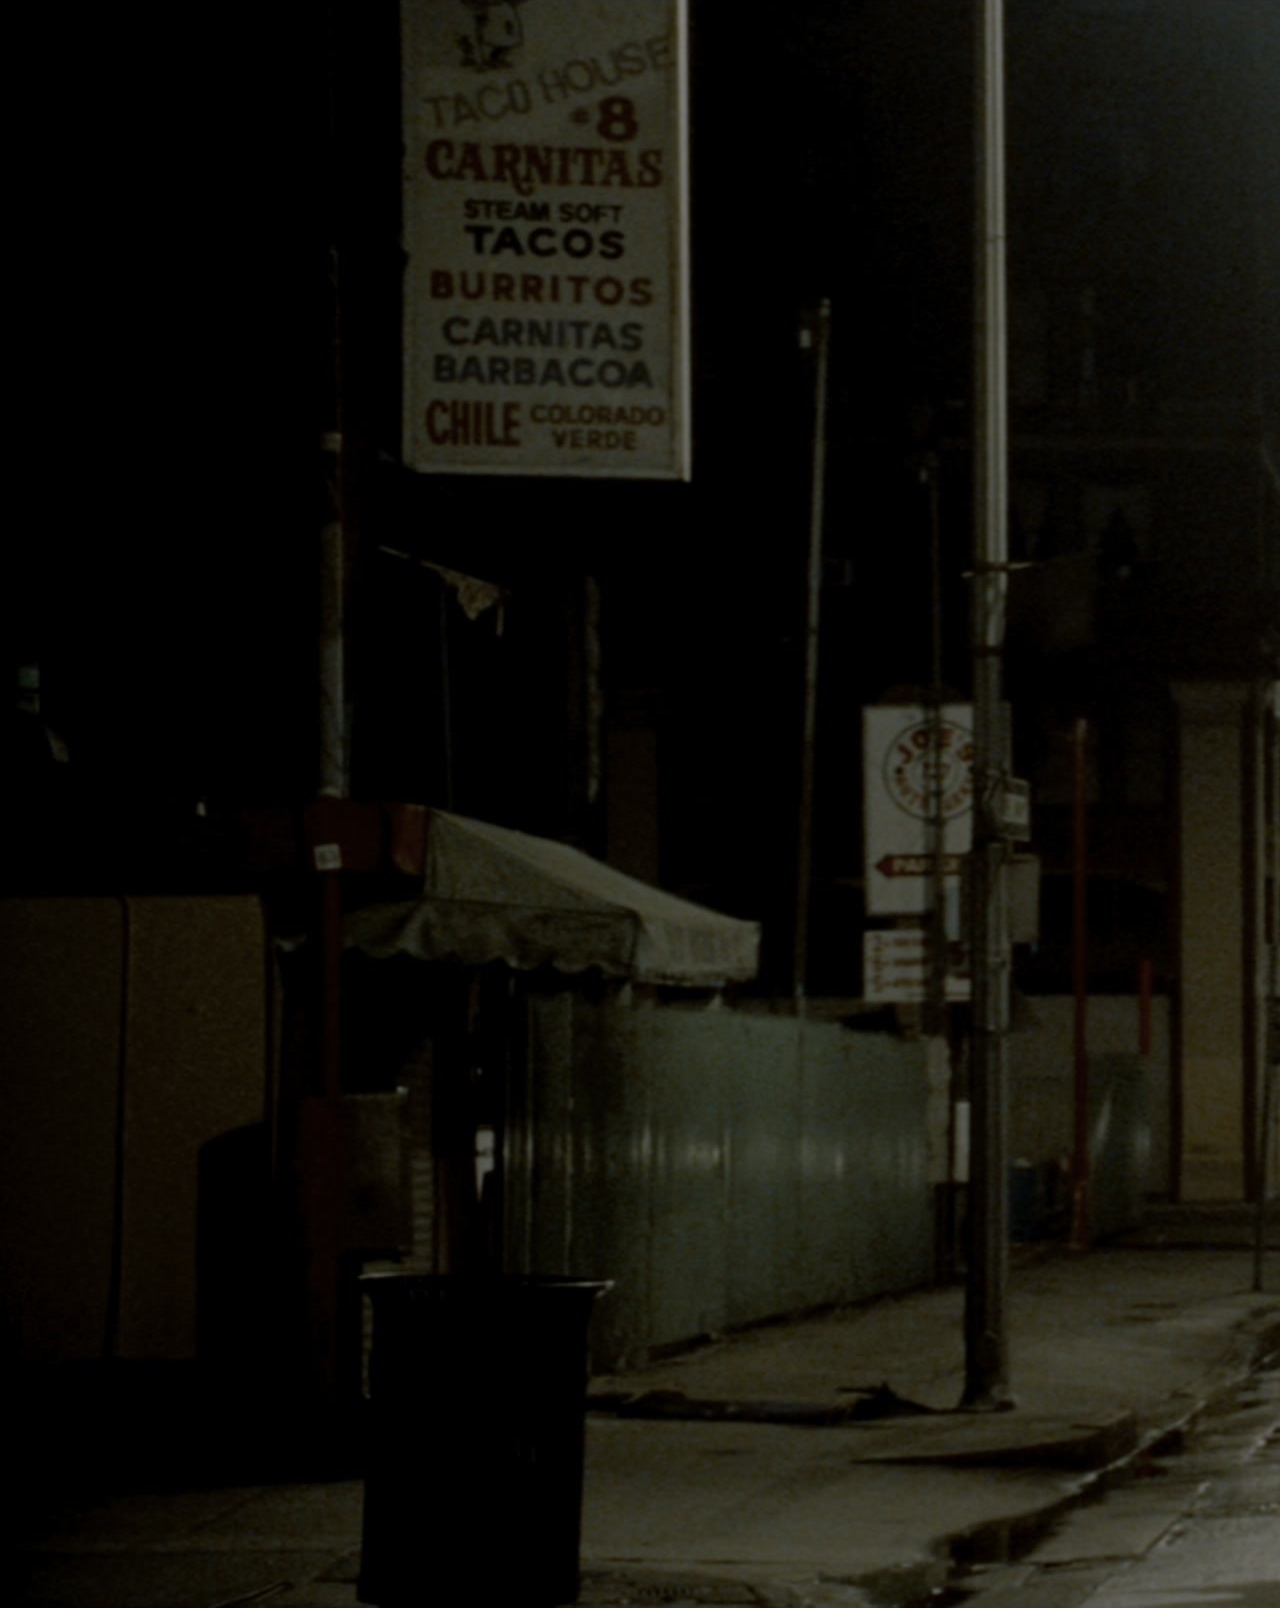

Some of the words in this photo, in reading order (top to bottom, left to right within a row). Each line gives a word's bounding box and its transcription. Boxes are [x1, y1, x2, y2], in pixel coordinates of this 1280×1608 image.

[424, 79, 532, 128] TACO
[539, 36, 674, 103] HOUSE
[426, 139, 663, 196] CARNITAS
[464, 199, 550, 221] STEAM
[559, 203, 624, 224] SOFT
[464, 226, 625, 260] TACOS
[430, 270, 654, 306] BURRITOS
[442, 316, 643, 351] CARNITAS
[434, 354, 654, 389] BARBACOA
[426, 400, 521, 447] CHILE
[530, 404, 666, 427] COLORADO
[551, 429, 637, 451] VERDE
